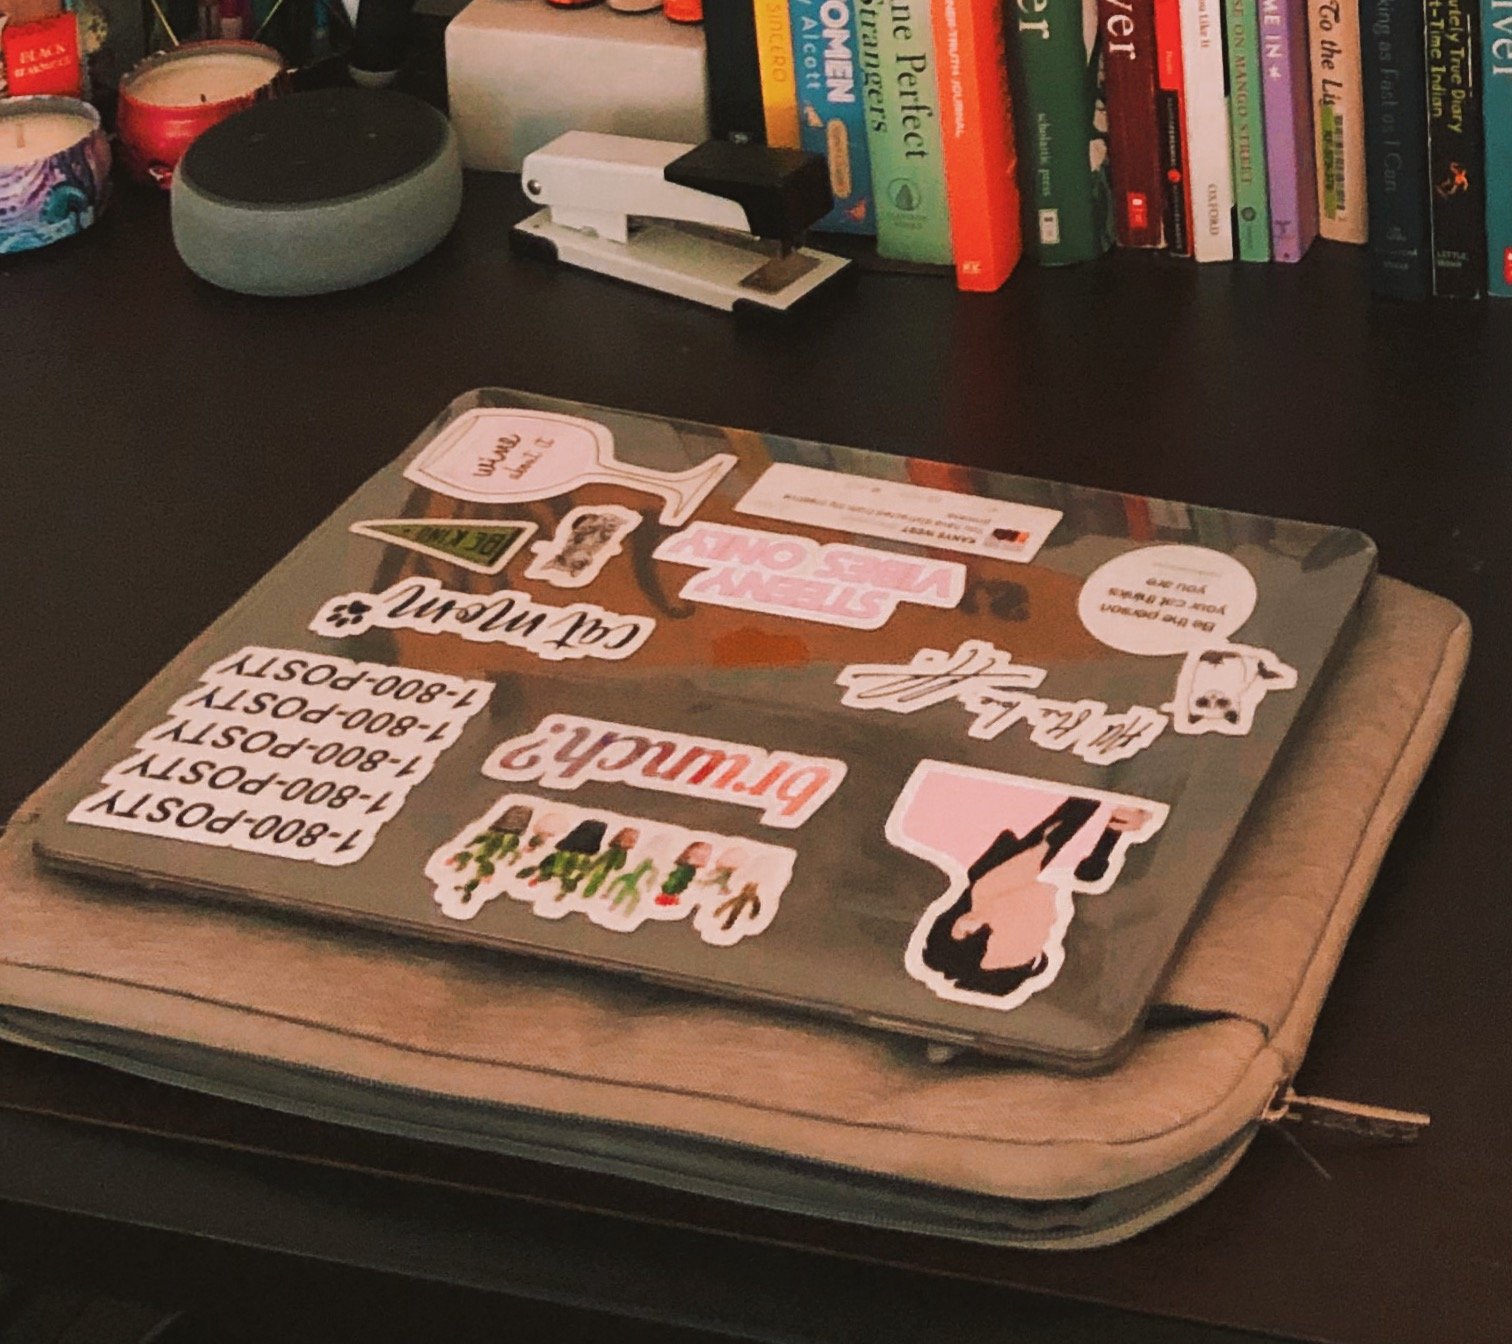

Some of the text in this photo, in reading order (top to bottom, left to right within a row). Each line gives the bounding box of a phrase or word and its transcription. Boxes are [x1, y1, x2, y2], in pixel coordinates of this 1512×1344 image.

[765, 1, 788, 82] SINCERO
[1233, 28, 1247, 49] ON
[1318, 0, 1340, 32] To
[799, 15, 823, 91] Alcott
[1264, 34, 1281, 59] IN
[1321, 40, 1342, 69] the
[1378, 41, 1393, 62] as
[1448, 47, 1465, 84] True
[895, 53, 931, 160] Perfect
[1234, 55, 1249, 118] MANGO
[1378, 68, 1397, 108] Fast
[1430, 65, 1446, 118] Indian
[1446, 89, 1466, 134] Diary
[1237, 123, 1253, 186] STREET
[1384, 152, 1401, 192] Can
[1206, 183, 1220, 236] OXFORD
[666, 527, 954, 596] VIBES ONLY
[1146, 576, 1208, 595] you are
[383, 583, 641, 651] cat mom
[690, 568, 888, 621] STEENY
[1100, 601, 1215, 633] Be the person
[1109, 585, 1227, 618] your cat thinks
[217, 653, 480, 711] 1-800-POSTY
[183, 685, 453, 745] 1-800-POSTY
[153, 719, 423, 781] 1-800-POSTY
[501, 720, 832, 819] brunch?
[119, 752, 393, 815] 1-800-POSTY
[87, 790, 360, 854] 1-800-POSTY
